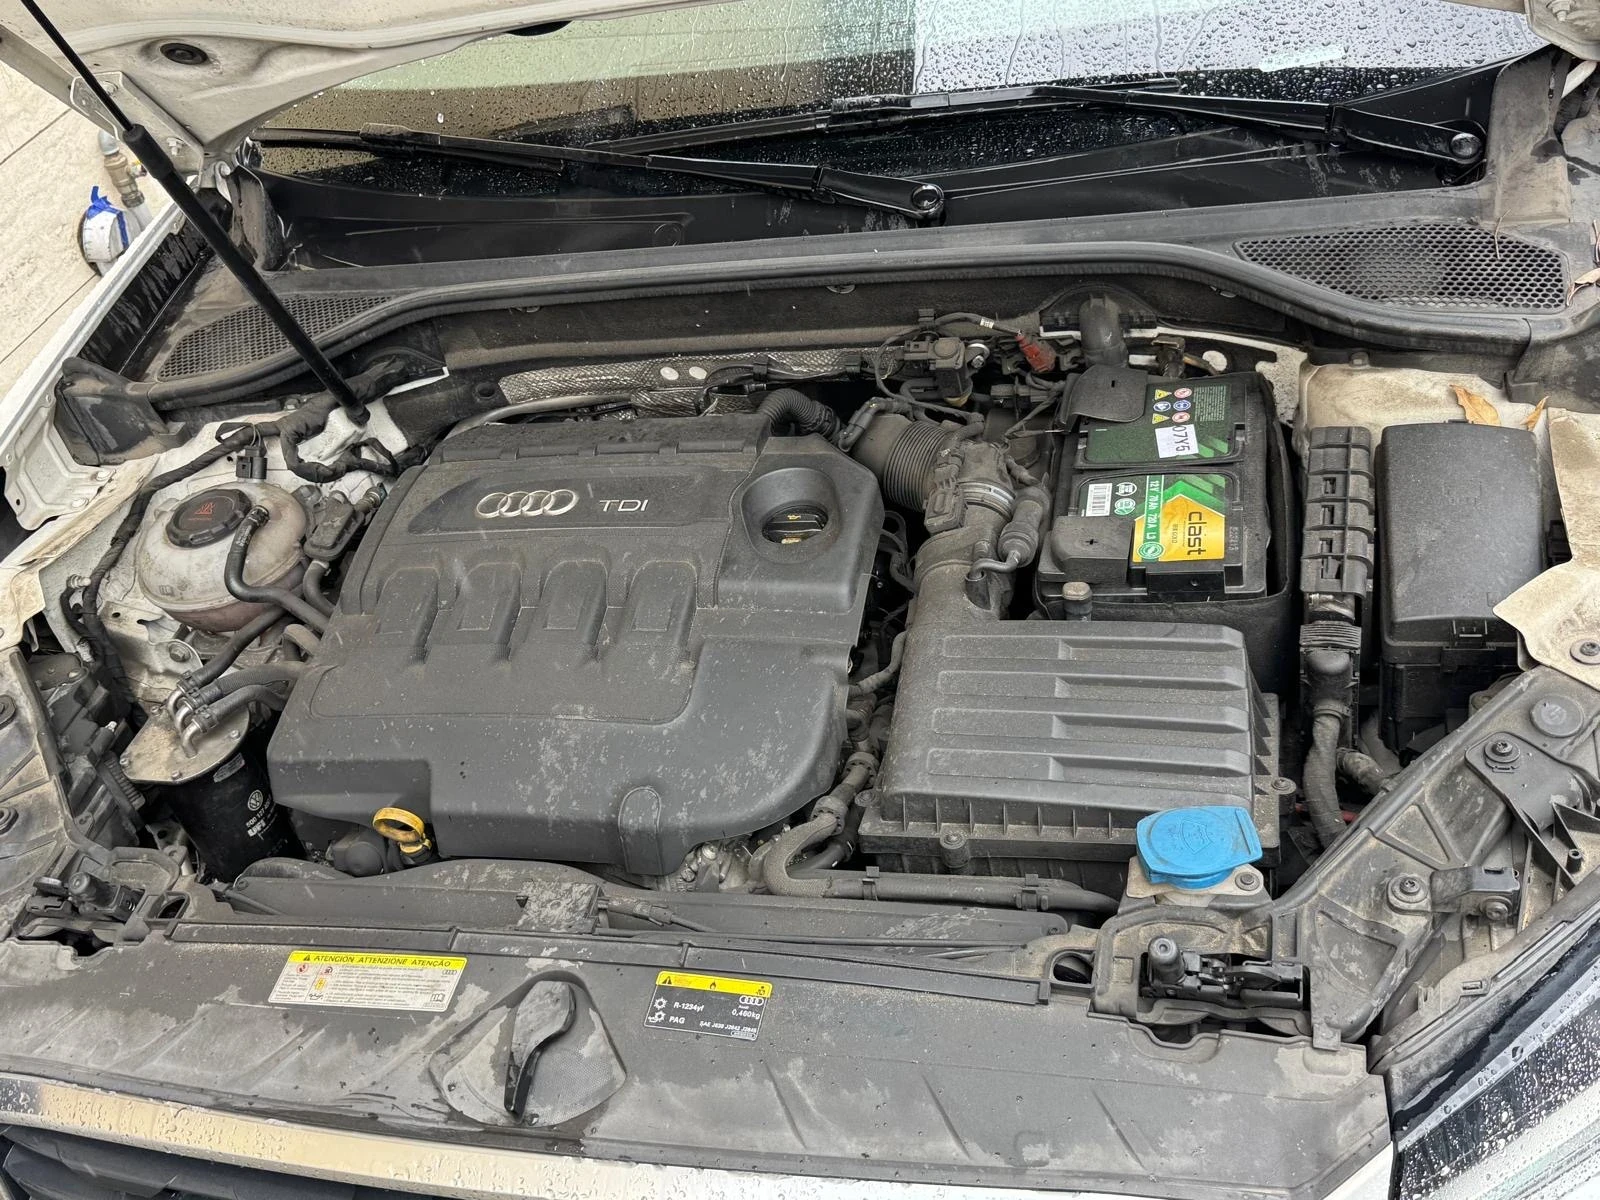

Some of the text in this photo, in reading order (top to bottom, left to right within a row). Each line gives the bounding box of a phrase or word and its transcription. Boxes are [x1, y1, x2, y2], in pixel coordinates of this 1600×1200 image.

[1172, 425, 1191, 452] 07Y5
[598, 499, 649, 512] TDI
[1187, 511, 1207, 556] clast
[358, 957, 408, 966] ATTENZIONE
[673, 1001, 705, 1012] R-1234yf
[668, 1015, 686, 1024] PAG
